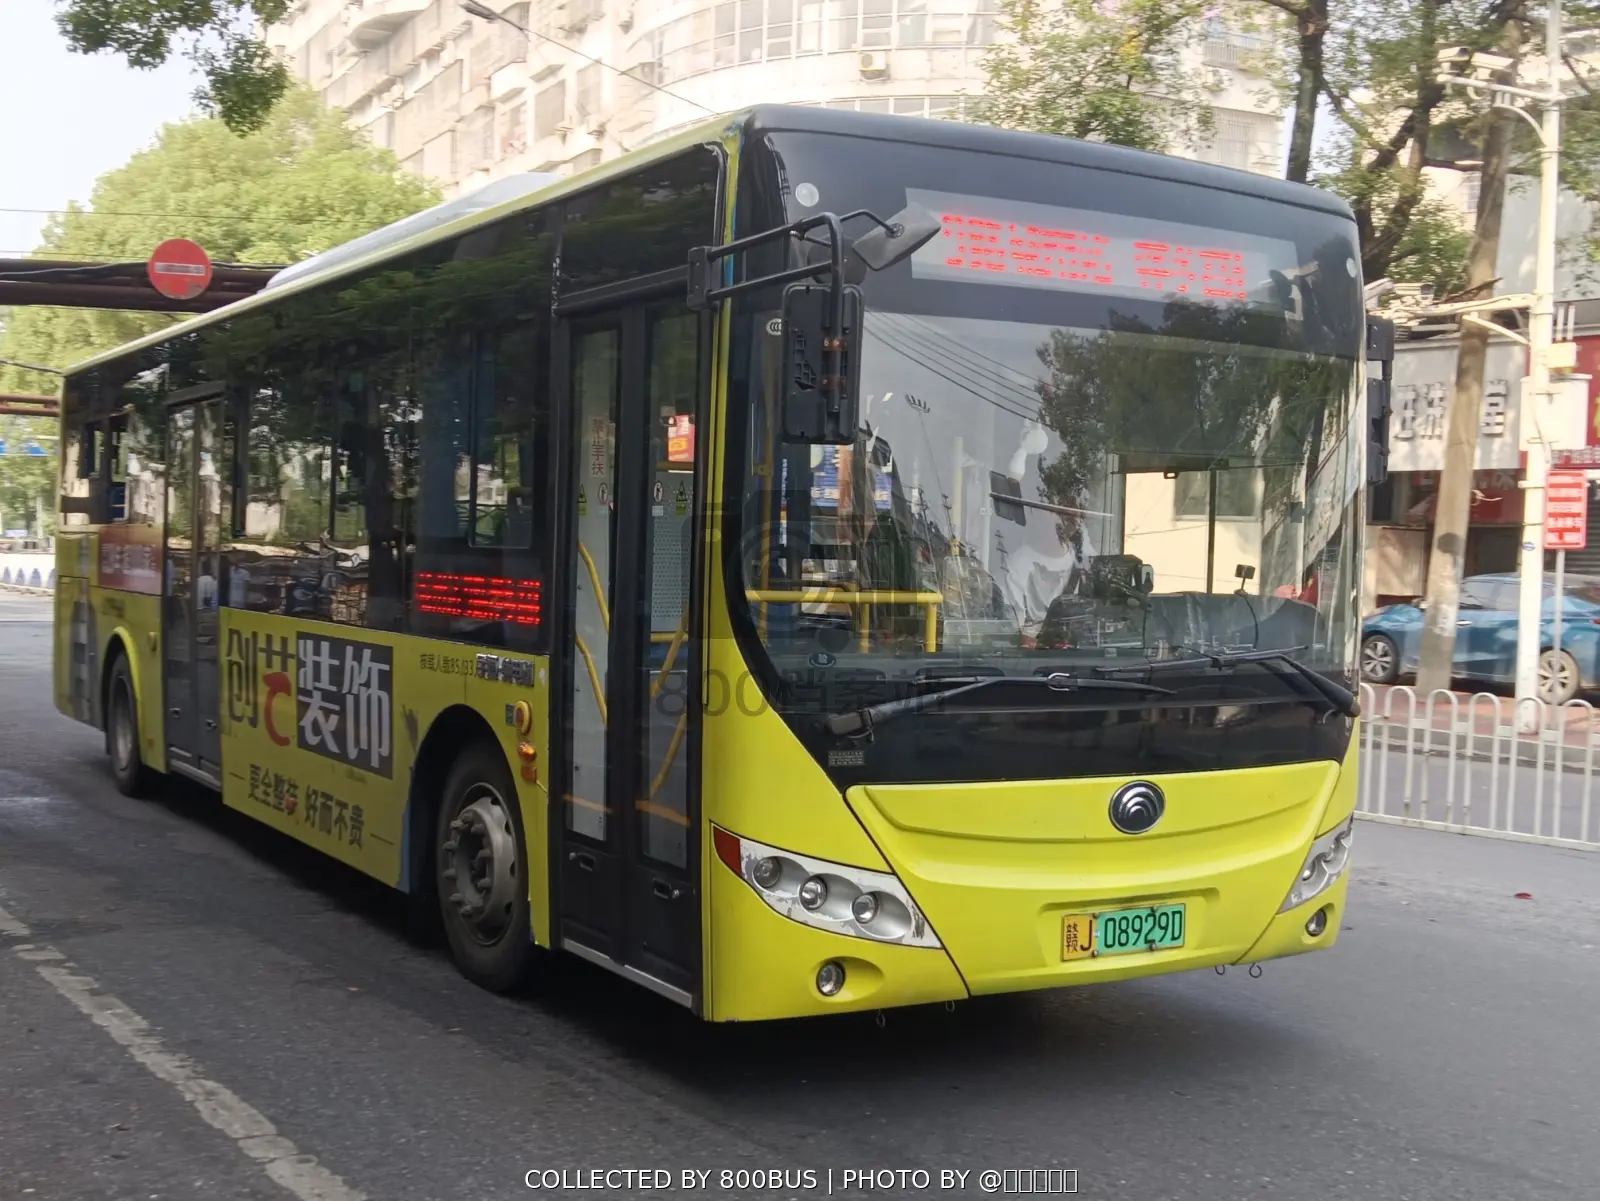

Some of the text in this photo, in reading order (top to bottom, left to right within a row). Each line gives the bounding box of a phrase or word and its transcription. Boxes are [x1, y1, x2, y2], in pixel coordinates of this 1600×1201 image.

[591, 417, 606, 476] 禁止手扶
[227, 628, 391, 769] 创艺装饰
[304, 784, 365, 851] 好而不贵
